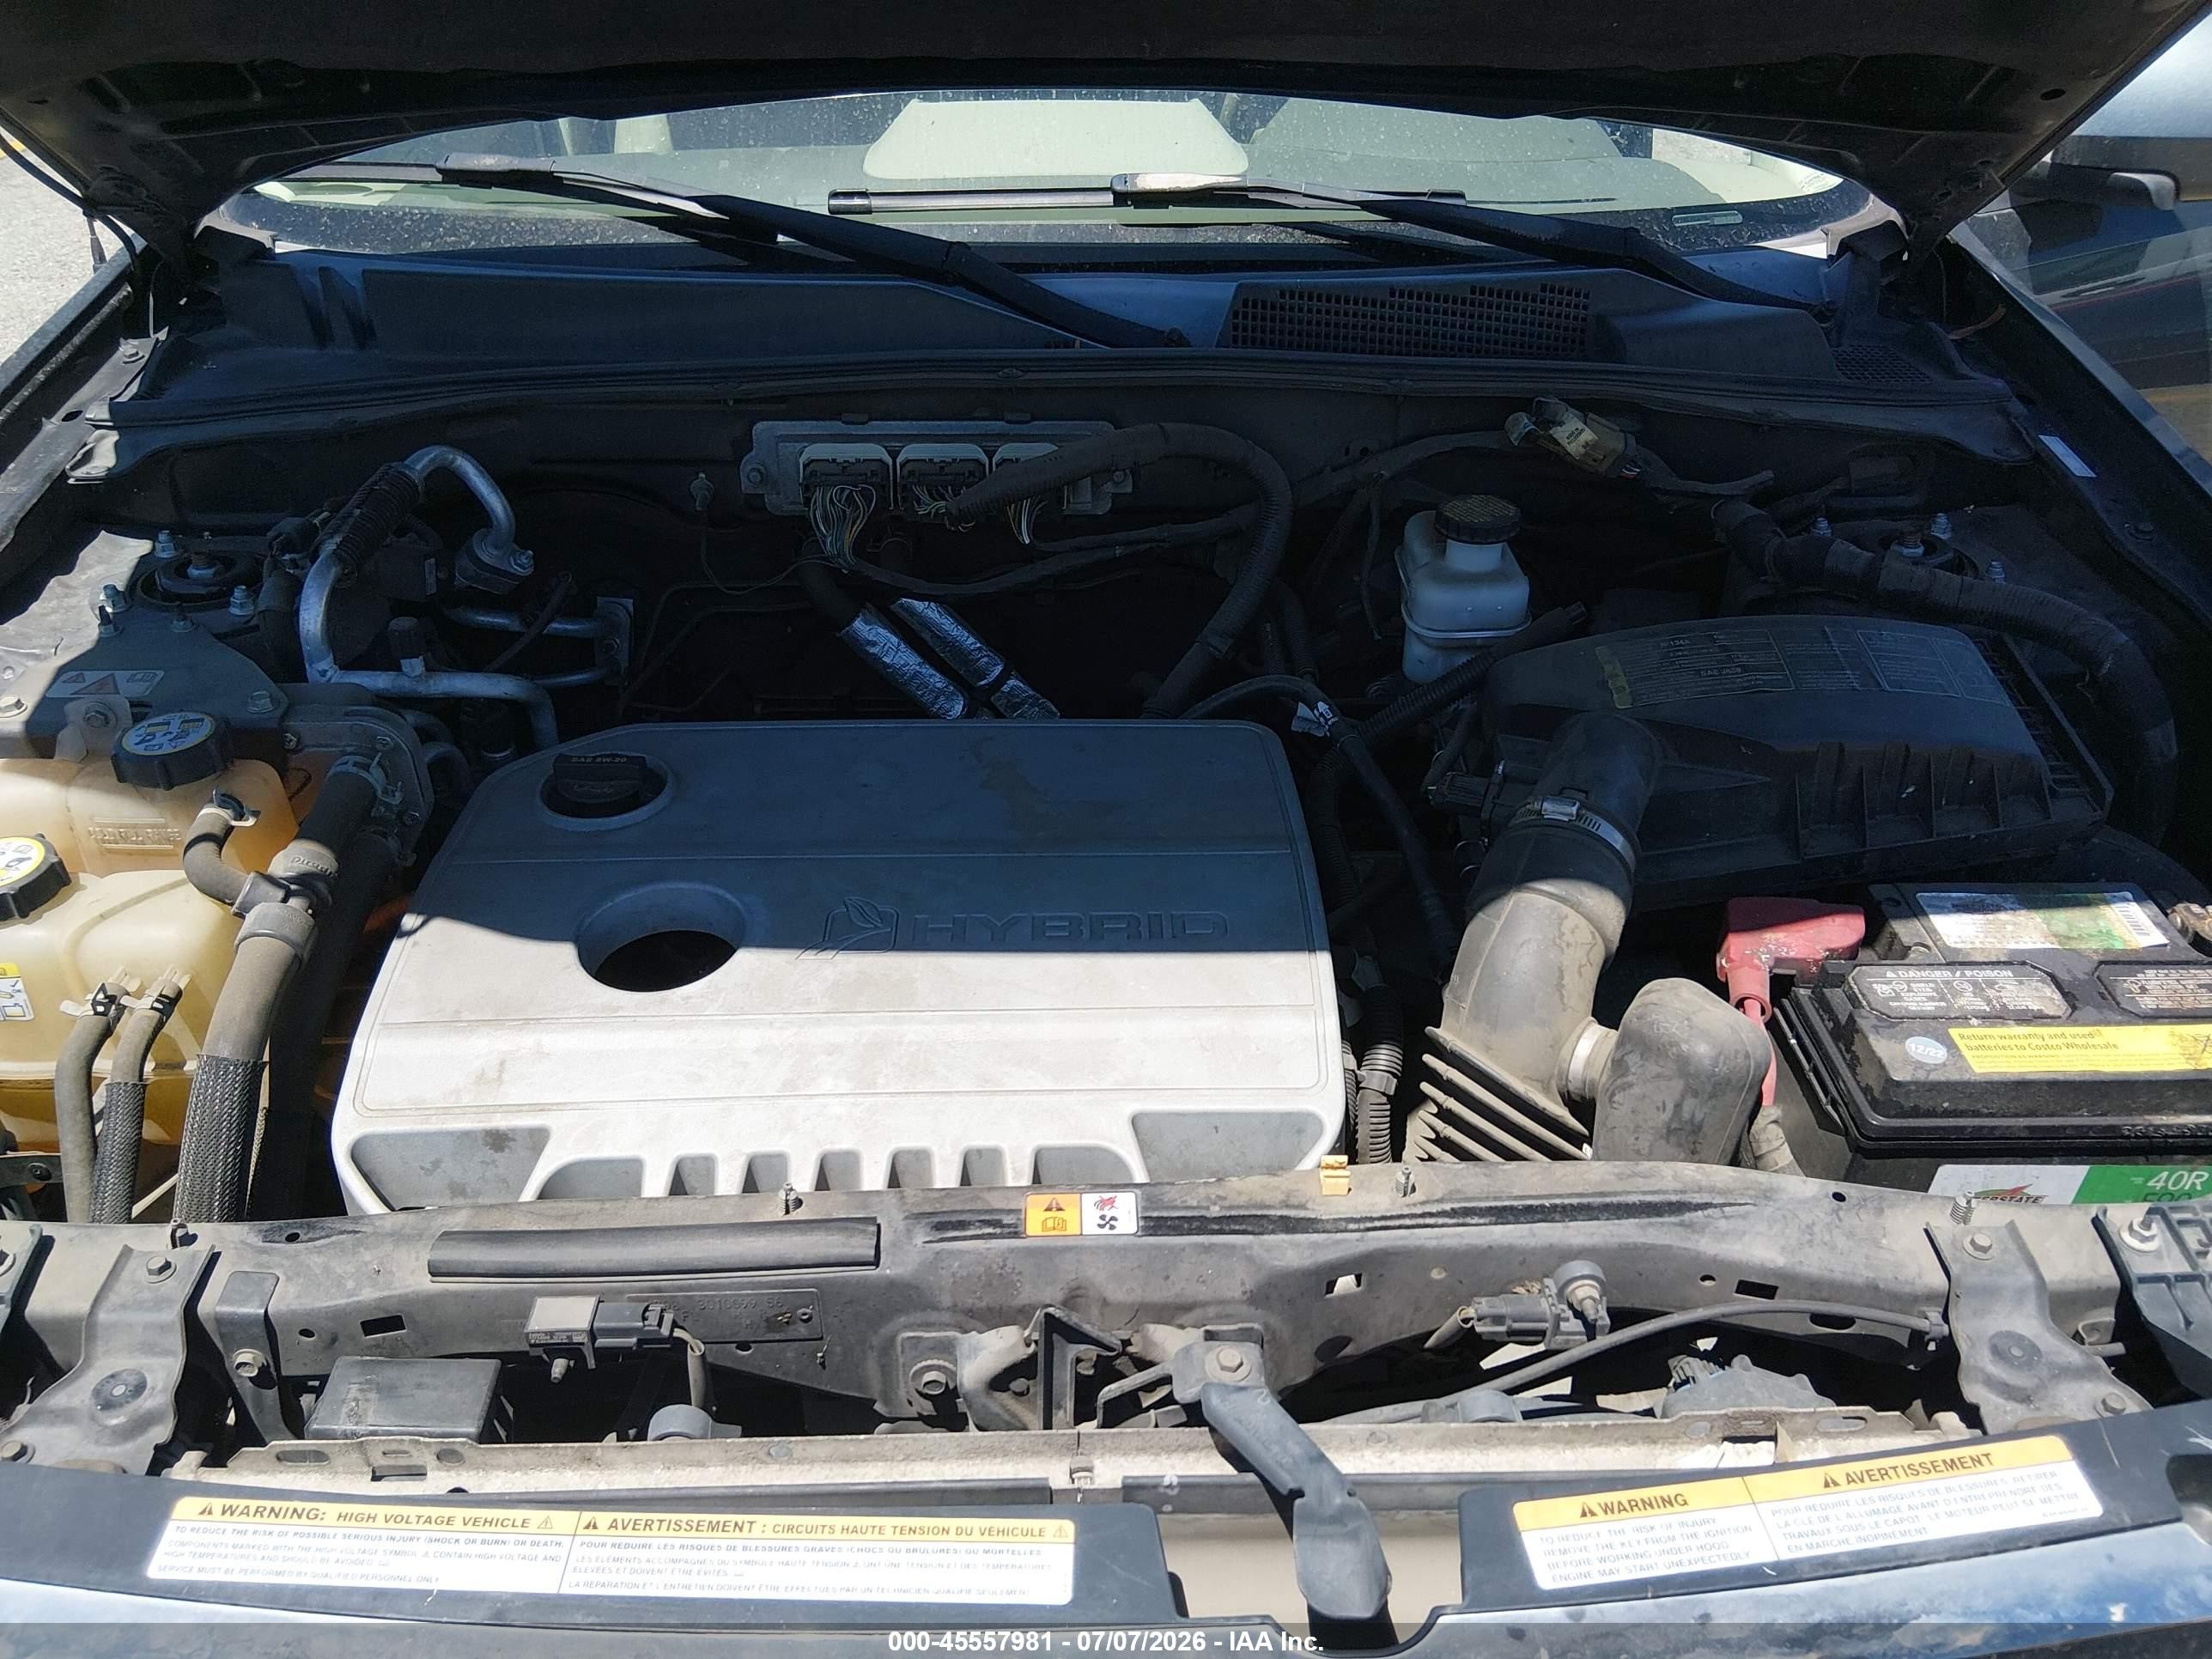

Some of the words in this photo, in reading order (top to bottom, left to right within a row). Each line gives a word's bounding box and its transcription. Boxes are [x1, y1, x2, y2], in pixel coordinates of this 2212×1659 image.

[912, 911, 1231, 943] HYBRID
[1897, 969, 1953, 978] DANGER
[1965, 969, 2014, 978] POISON
[1957, 1032, 1997, 1041] Return
[1997, 1033, 2045, 1042] warranty
[2047, 1031, 2067, 1040] and
[2069, 1030, 2095, 1039] used
[1908, 1042, 1945, 1060] 12/22
[1966, 1042, 2013, 1052] batteries
[2014, 1042, 2027, 1051] to
[2027, 1042, 2063, 1051] Costco
[2063, 1041, 2120, 1050] Wholesale
[2146, 1170, 2210, 1190] 40R
[1845, 1452, 1994, 1486] AVERTISSEMENT
[1597, 1492, 1689, 1516] WARNING
[1771, 1504, 1802, 1517] POUR
[1855, 1495, 1876, 1506] LES
[1879, 1490, 1925, 1504] RISQUES
[1927, 1487, 1942, 1497] DE
[221, 1503, 326, 1521] WARNING:
[336, 1511, 378, 1523] HIGH
[383, 1513, 457, 1527] VOLTAGE
[461, 1516, 532, 1528] VEHICLE
[1776, 1520, 1791, 1529] LA
[1817, 1514, 1832, 1523] DE
[1906, 1498, 1941, 1512] AVANT
[174, 1525, 187, 1534] TO
[189, 1526, 228, 1536] REDUCE
[231, 1528, 249, 1536] THE
[252, 1528, 274, 1537] RISK
[292, 1531, 337, 1540] POSSIBLE
[341, 1533, 383, 1542] SERIOUS
[386, 1534, 422, 1543] INJURY
[464, 1537, 478, 1546] OR
[607, 1517, 757, 1534] AVERTISSEMENT
[772, 1523, 836, 1534] CIRCUITS
[840, 1524, 887, 1535] HAUTE
[892, 1525, 951, 1537] TENSION
[955, 1526, 975, 1537] DU
[1607, 1527, 1627, 1537] THE
[1632, 1524, 1657, 1535] RISK
[1677, 1516, 1717, 1529] INJURY
[1782, 1528, 1833, 1542] TRAVAUX
[1836, 1522, 1867, 1534] SOUS
[1869, 1521, 1882, 1530] LE
[580, 1540, 608, 1549] POUR
[657, 1542, 676, 1551] LES
[678, 1543, 723, 1552] RISQUES
[742, 1544, 799, 1553] BLESSURES
[1595, 1540, 1615, 1551] THE
[1644, 1533, 1677, 1546] FROM
[1680, 1529, 1702, 1541] THE
[1704, 1524, 1753, 1539] IGNITION
[1787, 1544, 1804, 1553] EN
[1805, 1537, 1853, 1552] MARCHE
[433, 1551, 474, 1559] CONTAIN
[475, 1552, 496, 1560] HIGH
[499, 1553, 539, 1562] VOLTAGE
[542, 1554, 562, 1563] AND
[1552, 1571, 1595, 1583] ENGINE
[1597, 1565, 1623, 1577] MAY
[1626, 1561, 1659, 1574] START
[1663, 1551, 1751, 1571] UNEXPECTEDLY
[1596, 1550, 1653, 1565] WORKING
[197, 1566, 222, 1575] MUST
